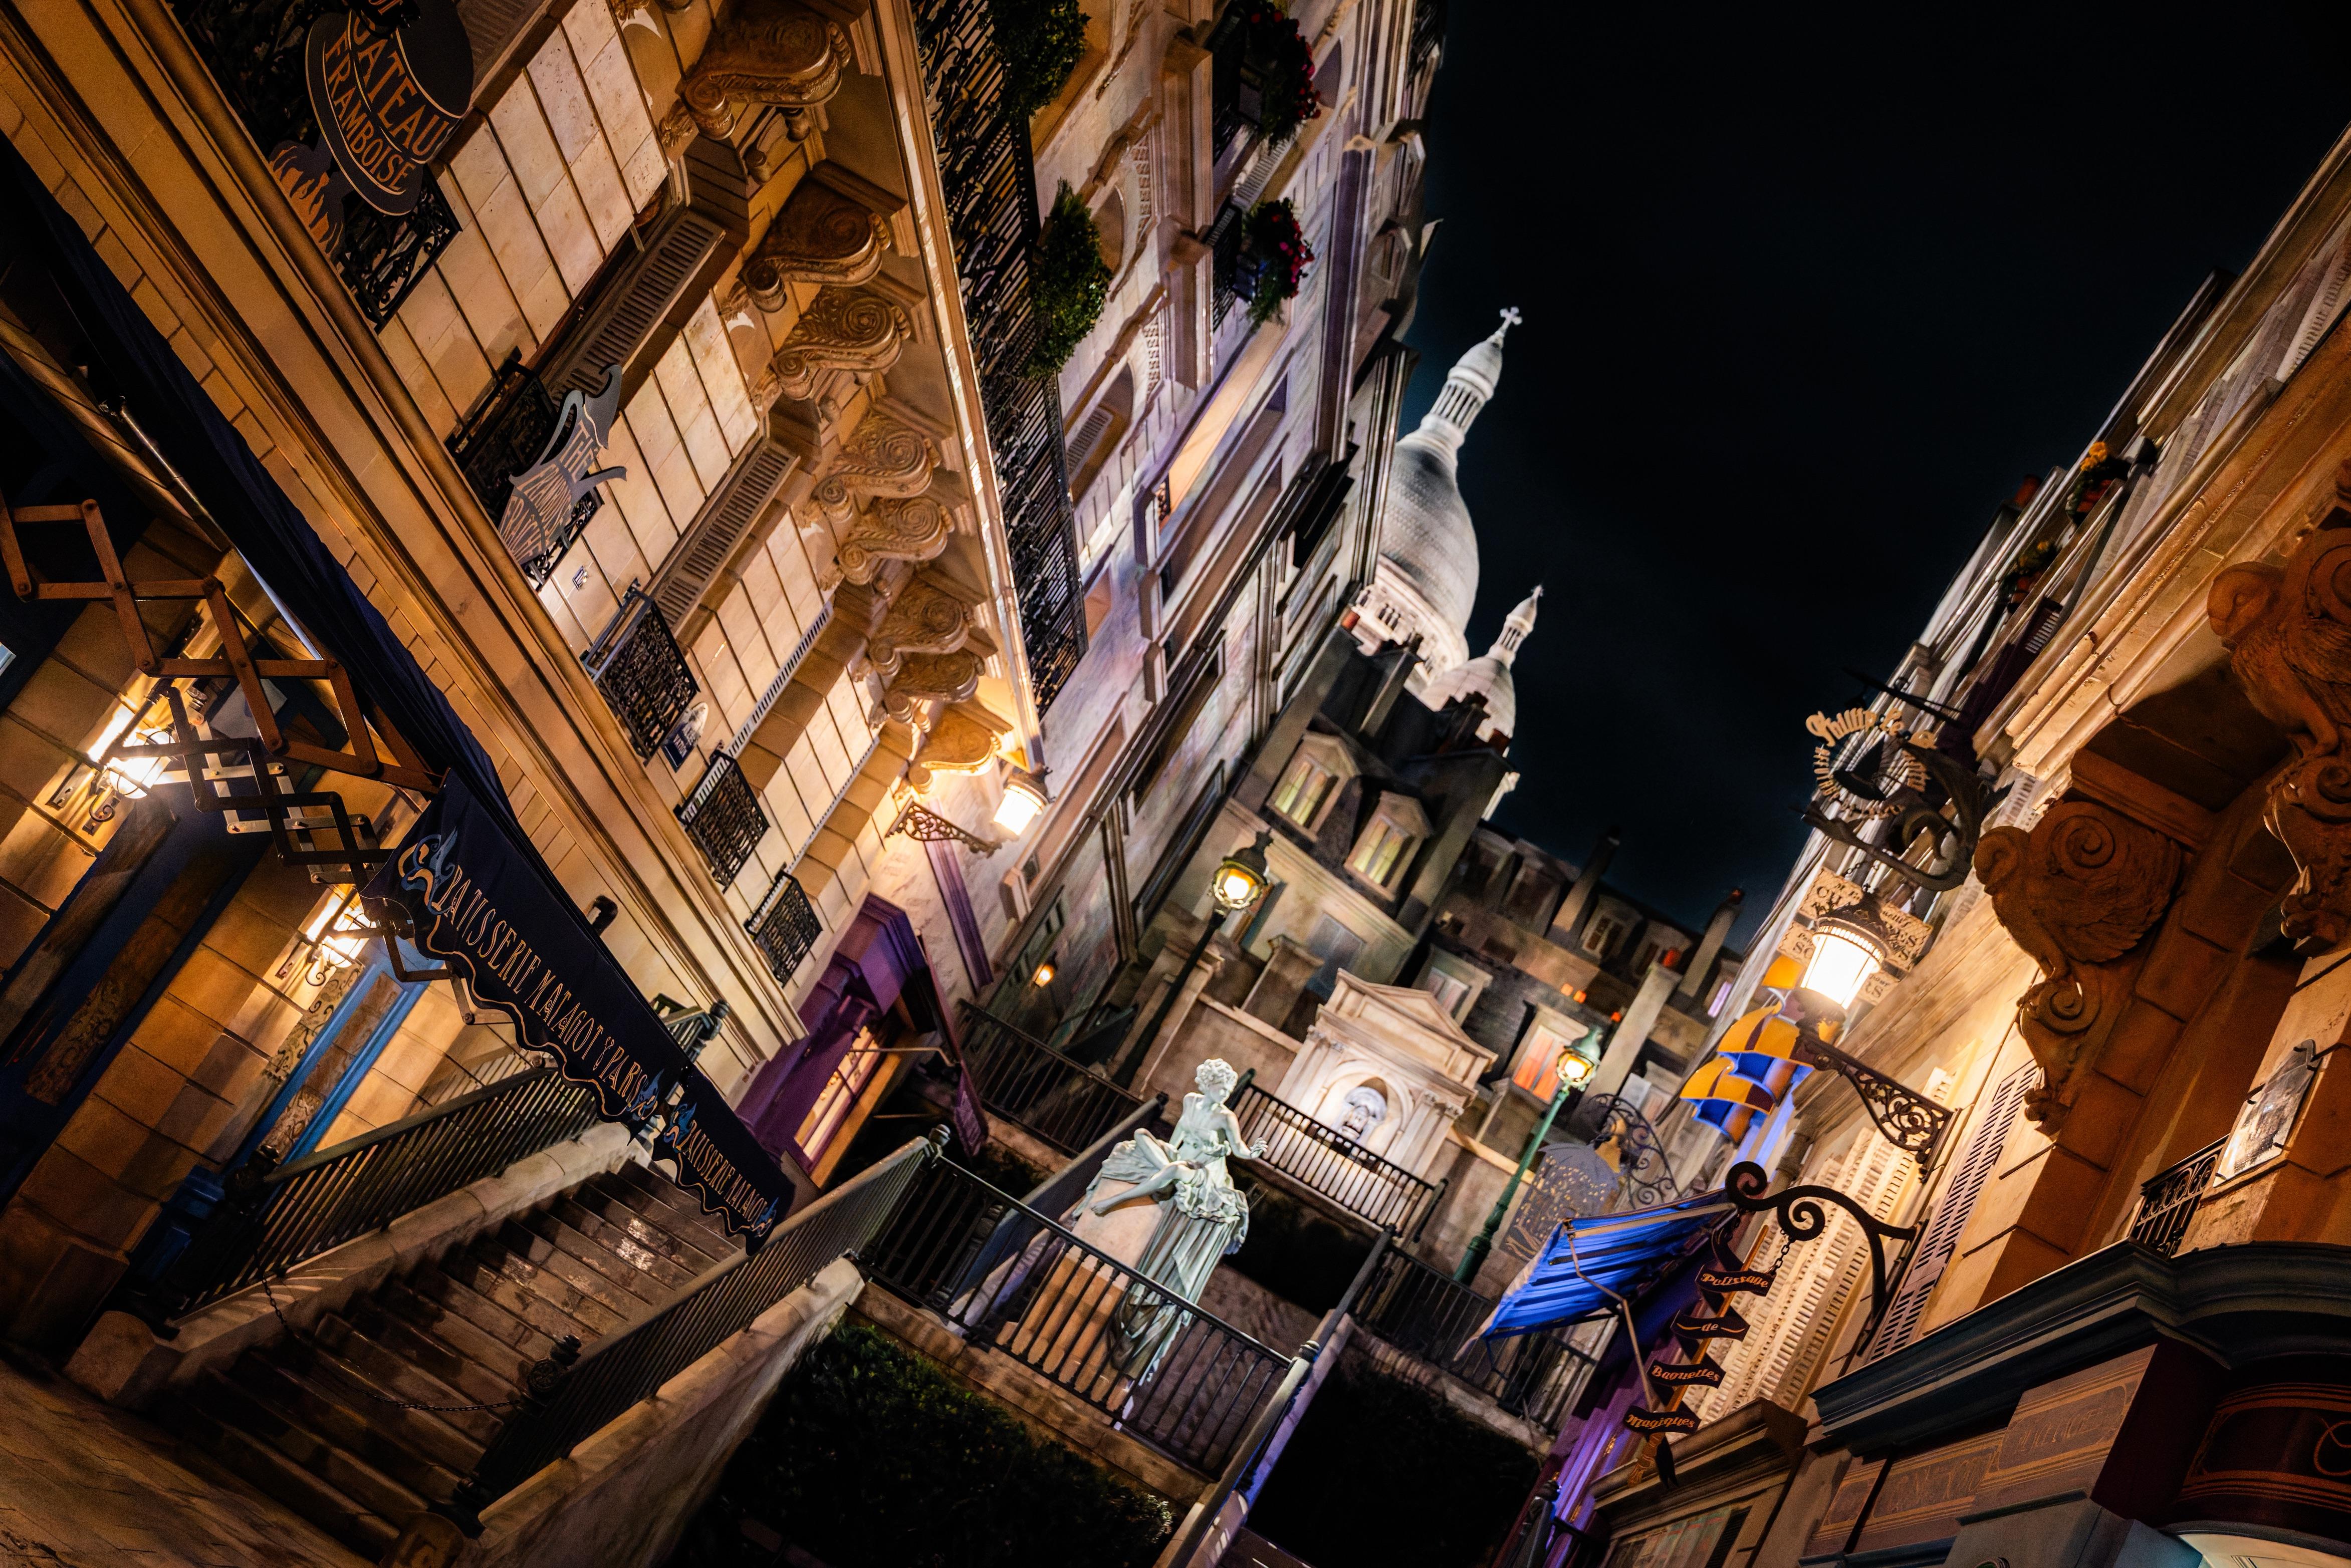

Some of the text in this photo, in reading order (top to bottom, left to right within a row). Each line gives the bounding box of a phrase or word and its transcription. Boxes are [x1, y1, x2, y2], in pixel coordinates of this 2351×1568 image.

[325, 30, 416, 191] FRAMBOISE
[525, 969, 604, 1060] MATAGOT
[1701, 1323, 1719, 1332] de
[1652, 1365, 1720, 1382] Baguettes
[1626, 1414, 1695, 1429] Magiques
